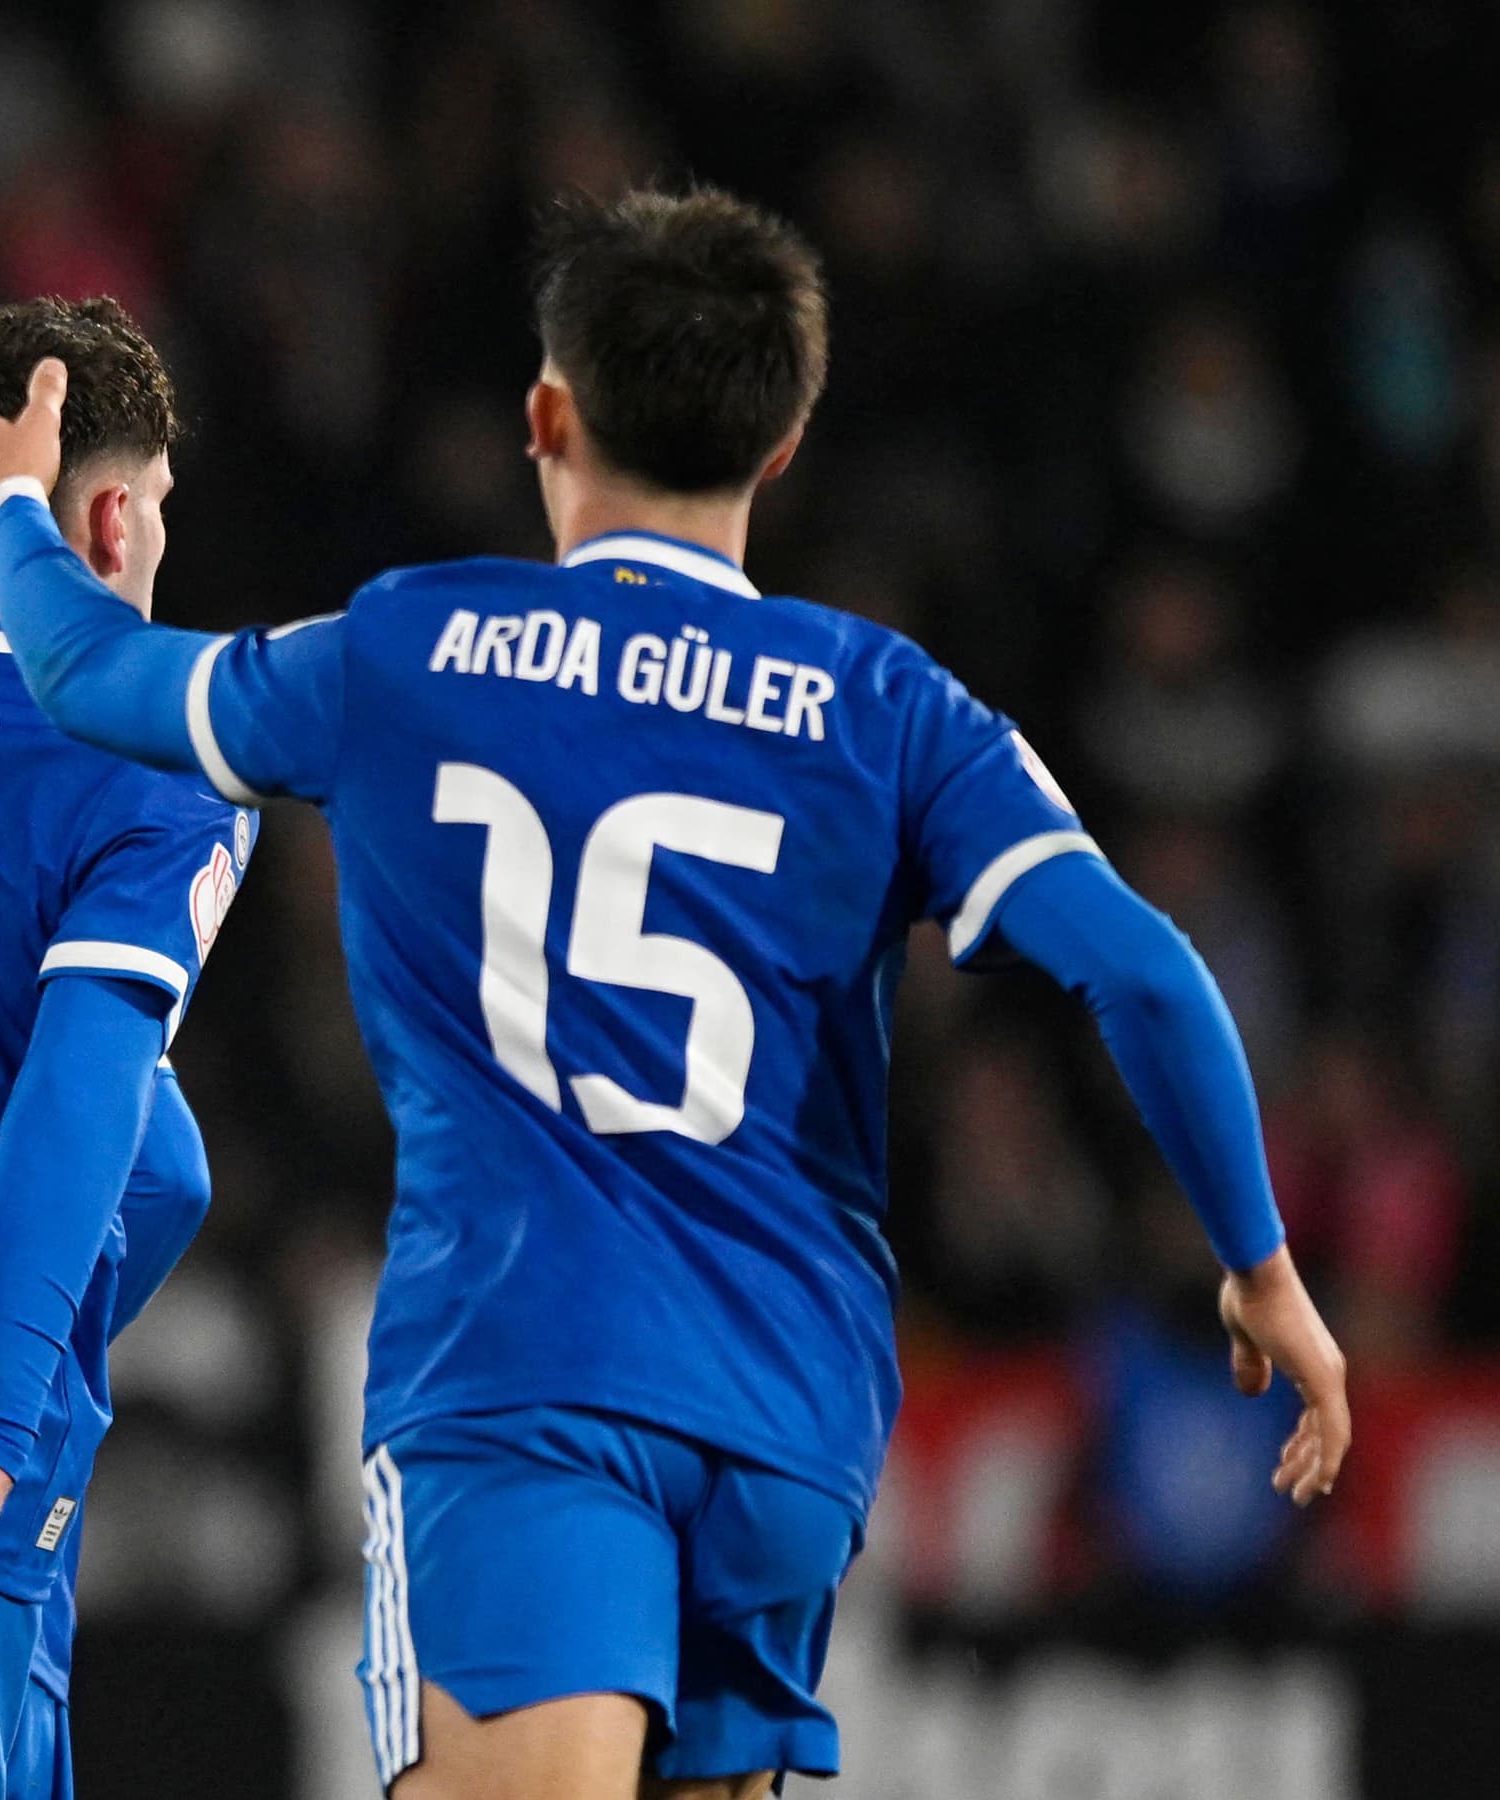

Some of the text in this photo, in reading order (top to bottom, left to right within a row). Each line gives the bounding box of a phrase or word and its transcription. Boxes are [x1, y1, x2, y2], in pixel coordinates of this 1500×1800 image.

[430, 609, 836, 742] ARDA GÜLER
[432, 762, 785, 1146] 15
